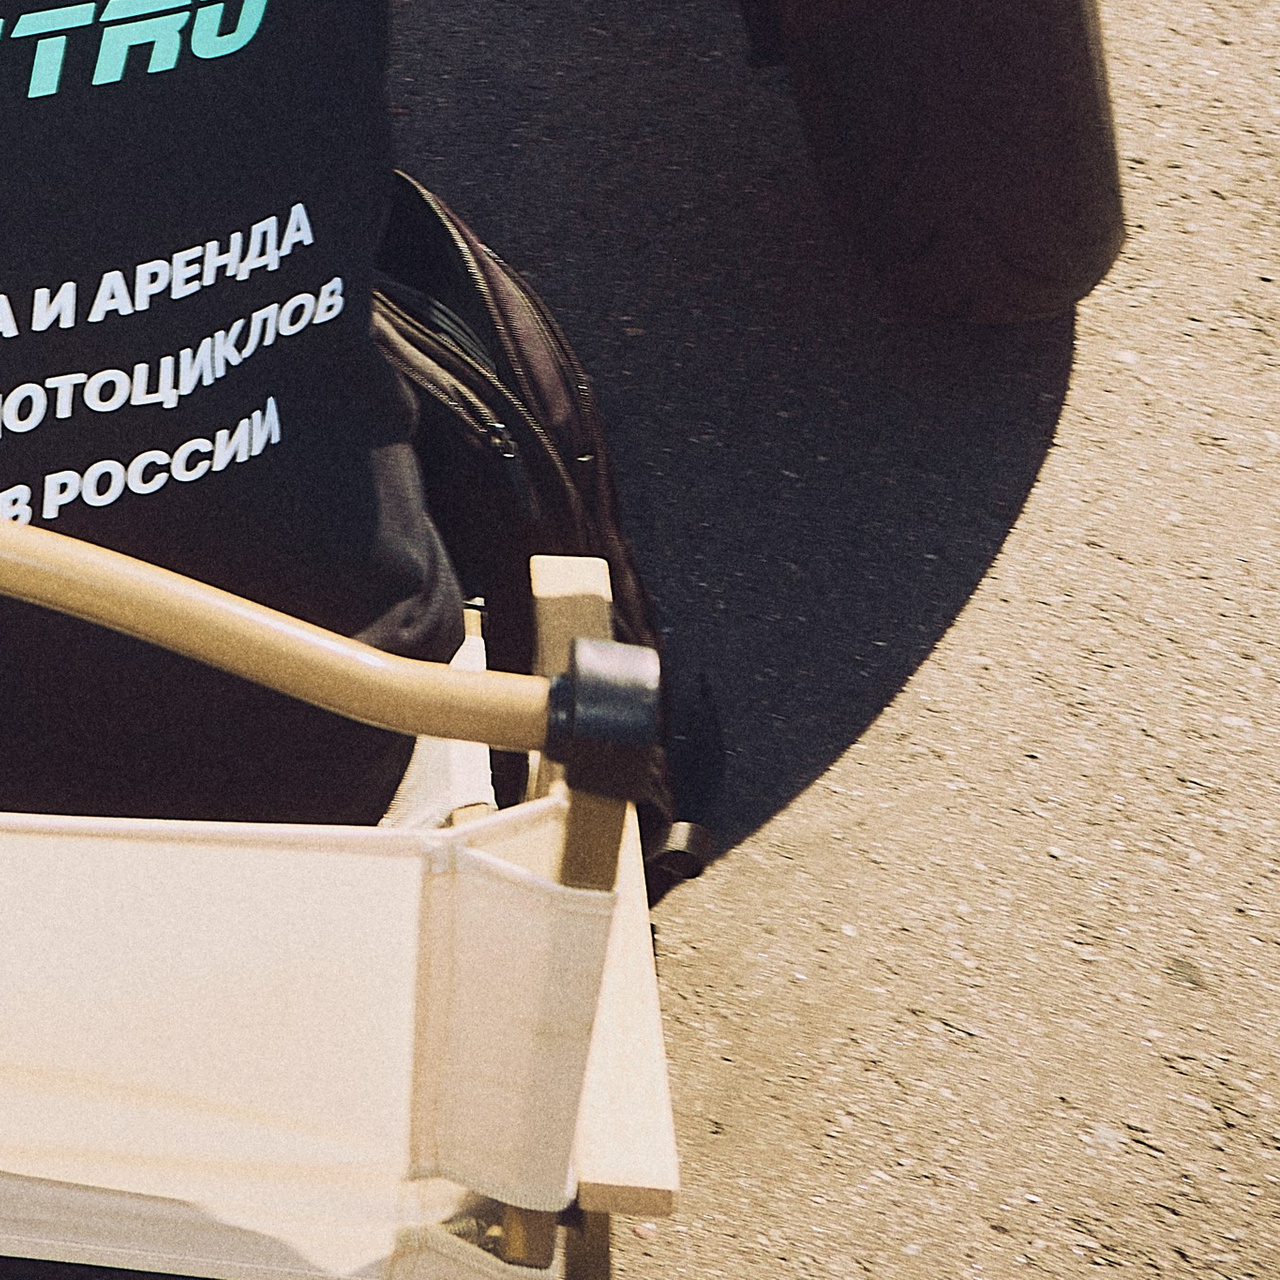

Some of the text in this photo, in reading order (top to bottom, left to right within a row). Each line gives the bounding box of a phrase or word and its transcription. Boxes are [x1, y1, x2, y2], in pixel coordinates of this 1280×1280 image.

[31, 281, 76, 332] И
[88, 203, 313, 322] АРЕНДА
[42, 396, 282, 519] РОССИИ
